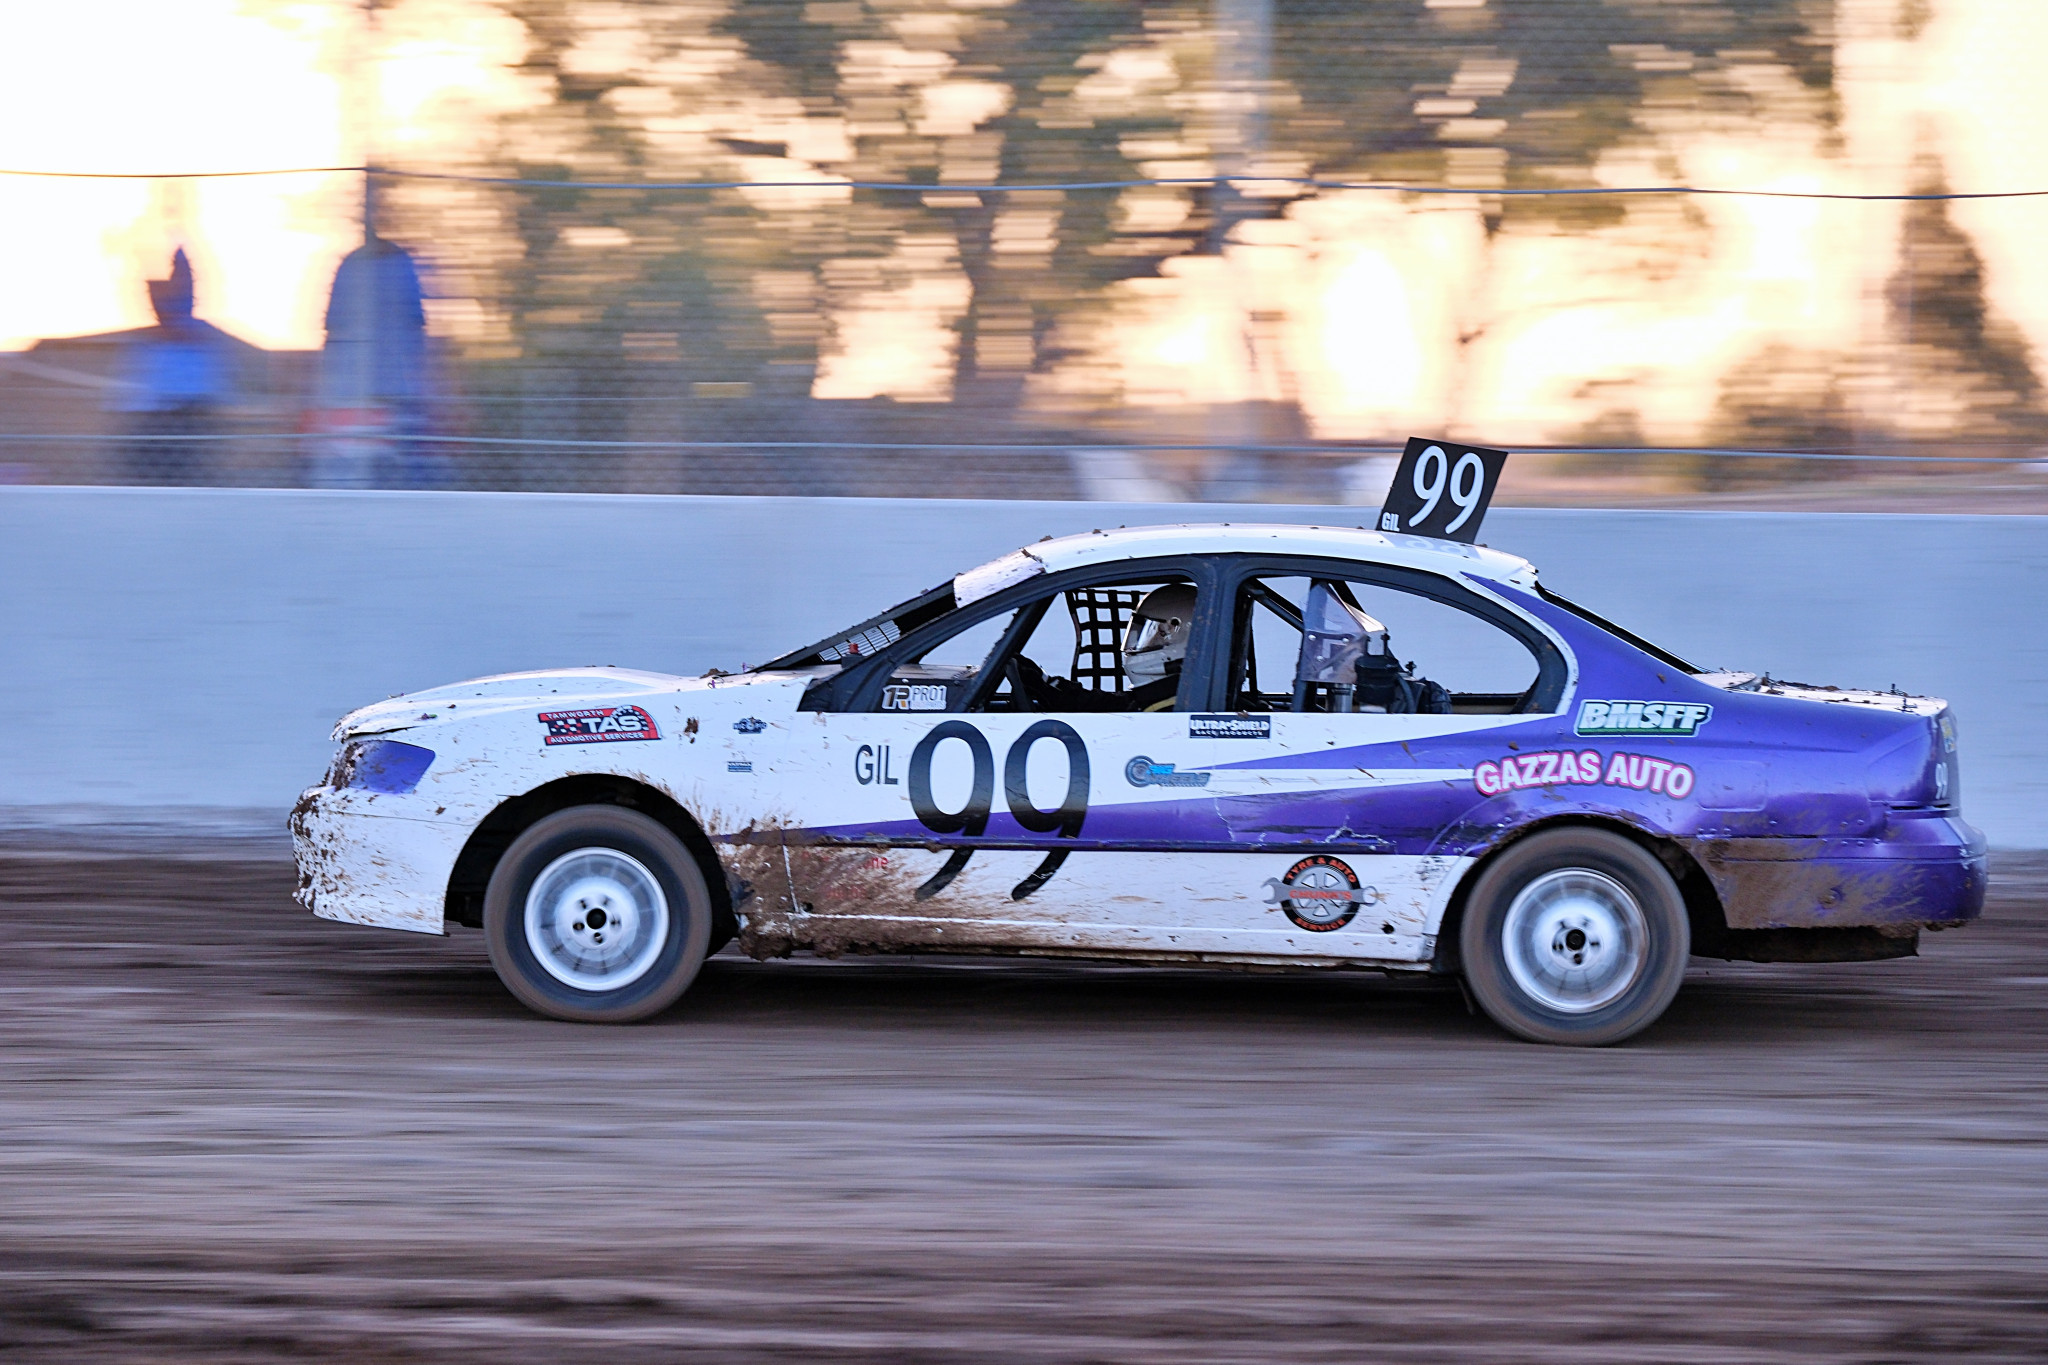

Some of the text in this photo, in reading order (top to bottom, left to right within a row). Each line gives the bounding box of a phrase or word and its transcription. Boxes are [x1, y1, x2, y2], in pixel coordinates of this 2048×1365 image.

[1408, 445, 1485, 534] 99
[1381, 511, 1400, 532] GIL
[912, 686, 946, 701] PRO1
[545, 709, 605, 720] TAMWORTH
[580, 715, 642, 734] TAS
[1577, 701, 1709, 733] BMSFF
[550, 731, 645, 744] AUTOMOTIVE SERVICES
[855, 743, 899, 786] GIL
[1475, 752, 1693, 797] GAZZAS AUTO
[908, 719, 1091, 901] 99
[1328, 859, 1357, 883] AUTO
